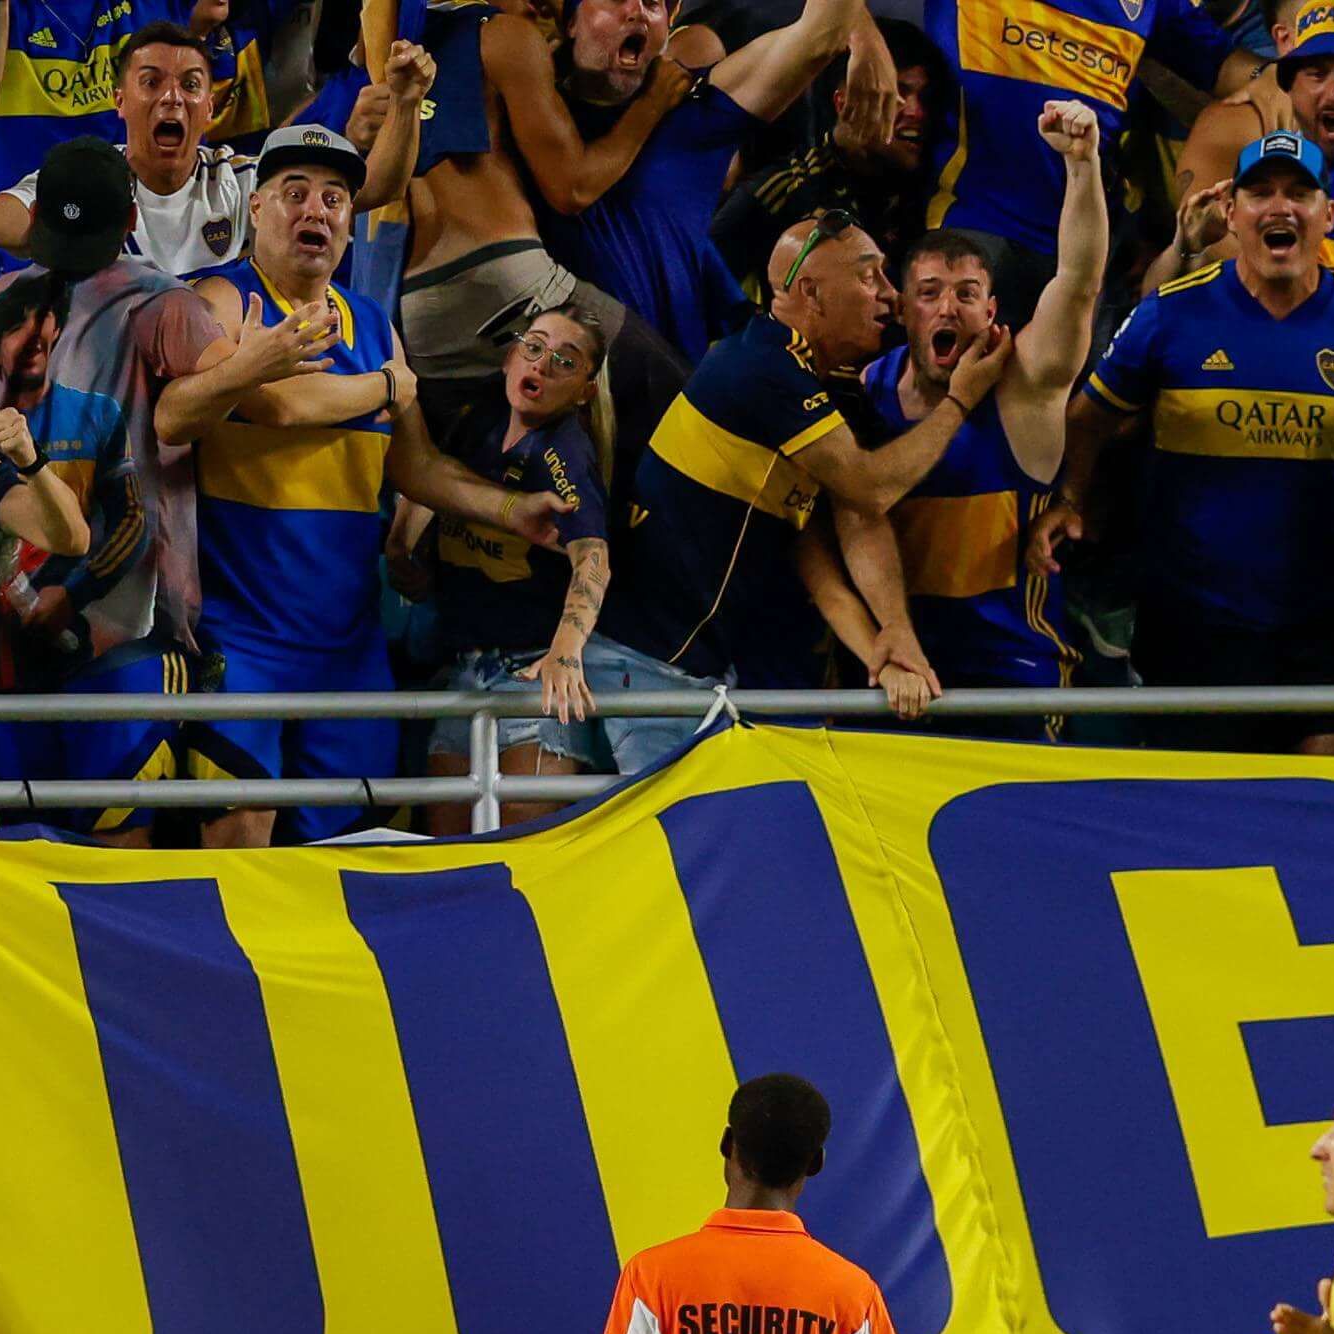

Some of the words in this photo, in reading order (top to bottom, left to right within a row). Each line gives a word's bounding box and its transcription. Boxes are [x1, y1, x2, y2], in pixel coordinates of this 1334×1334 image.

[1002, 16, 1132, 83] betsson
[1216, 400, 1326, 431] QATAR
[1244, 430, 1324, 448] AIRWAYS
[543, 447, 578, 498] unicef
